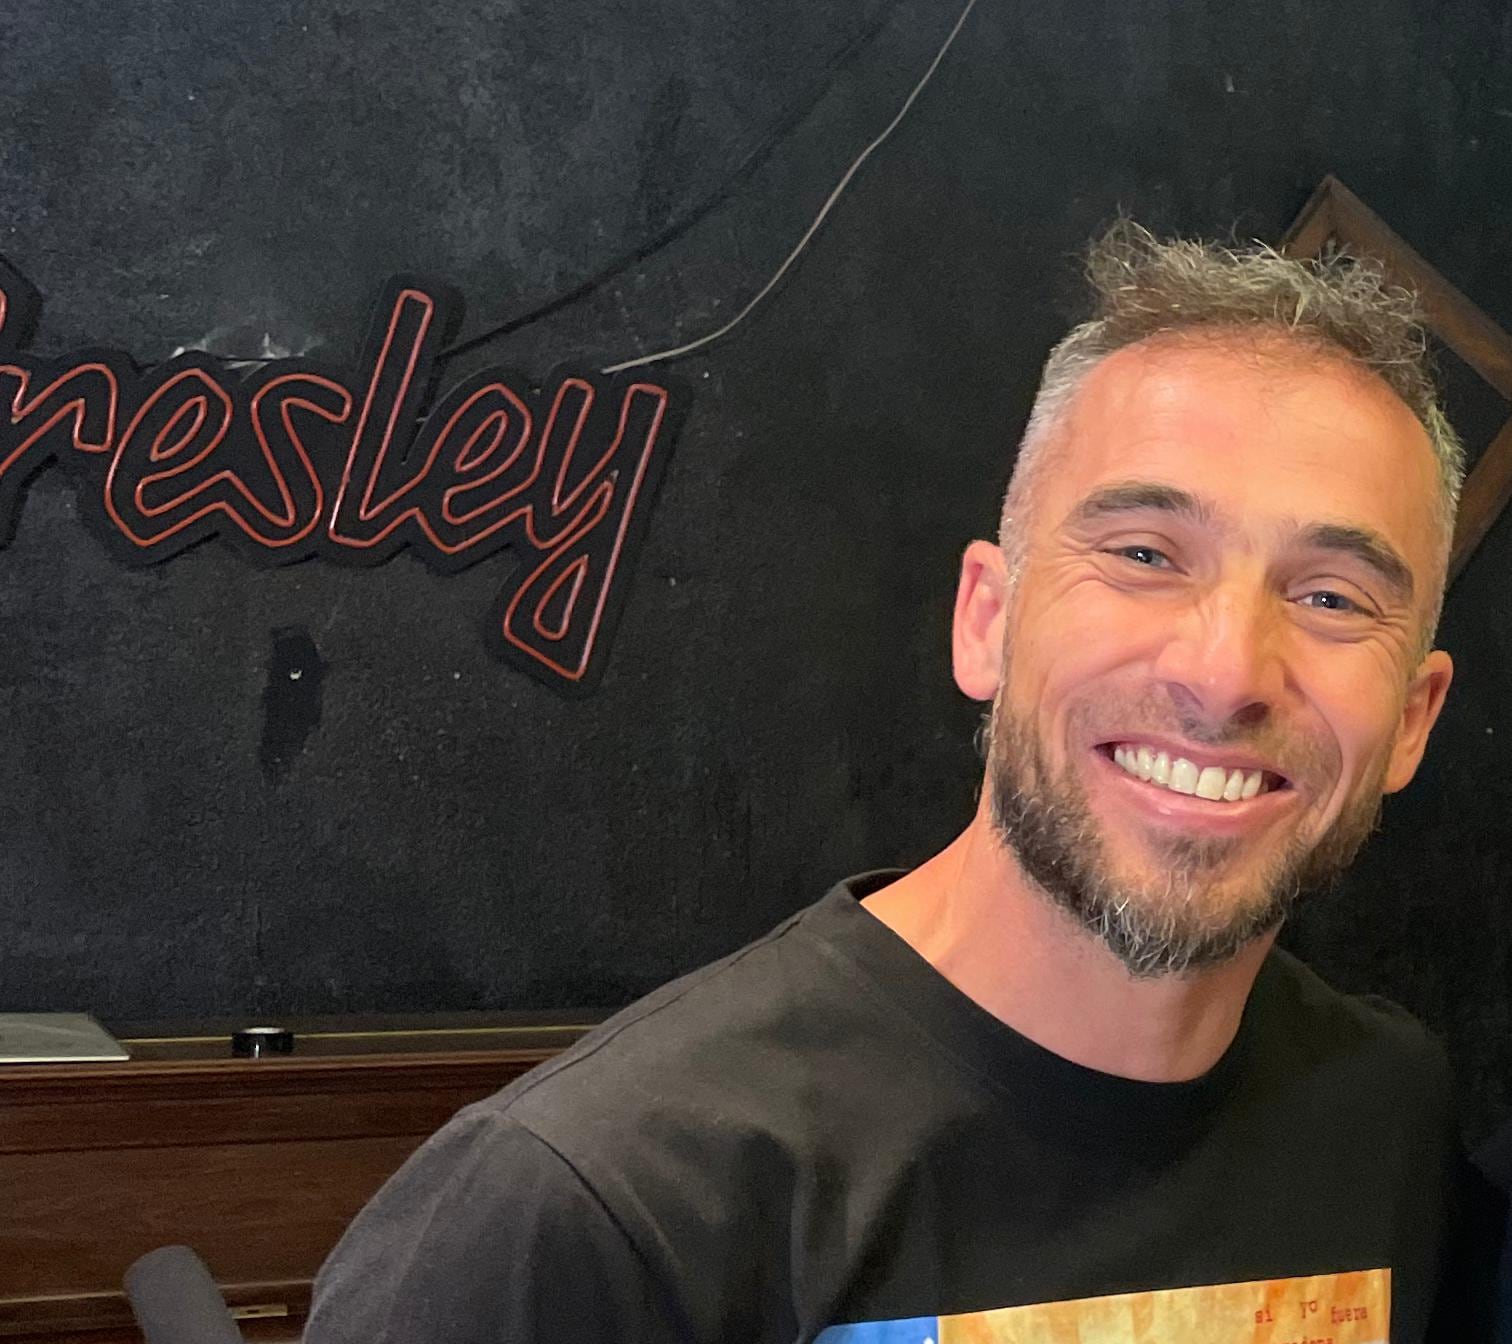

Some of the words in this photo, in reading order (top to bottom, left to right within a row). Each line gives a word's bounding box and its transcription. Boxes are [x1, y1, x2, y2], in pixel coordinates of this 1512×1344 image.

[0, 288, 668, 681] resley
[1255, 1309, 1273, 1324] si
[1300, 1300, 1318, 1319] yo
[1331, 1306, 1368, 1324] fuera
